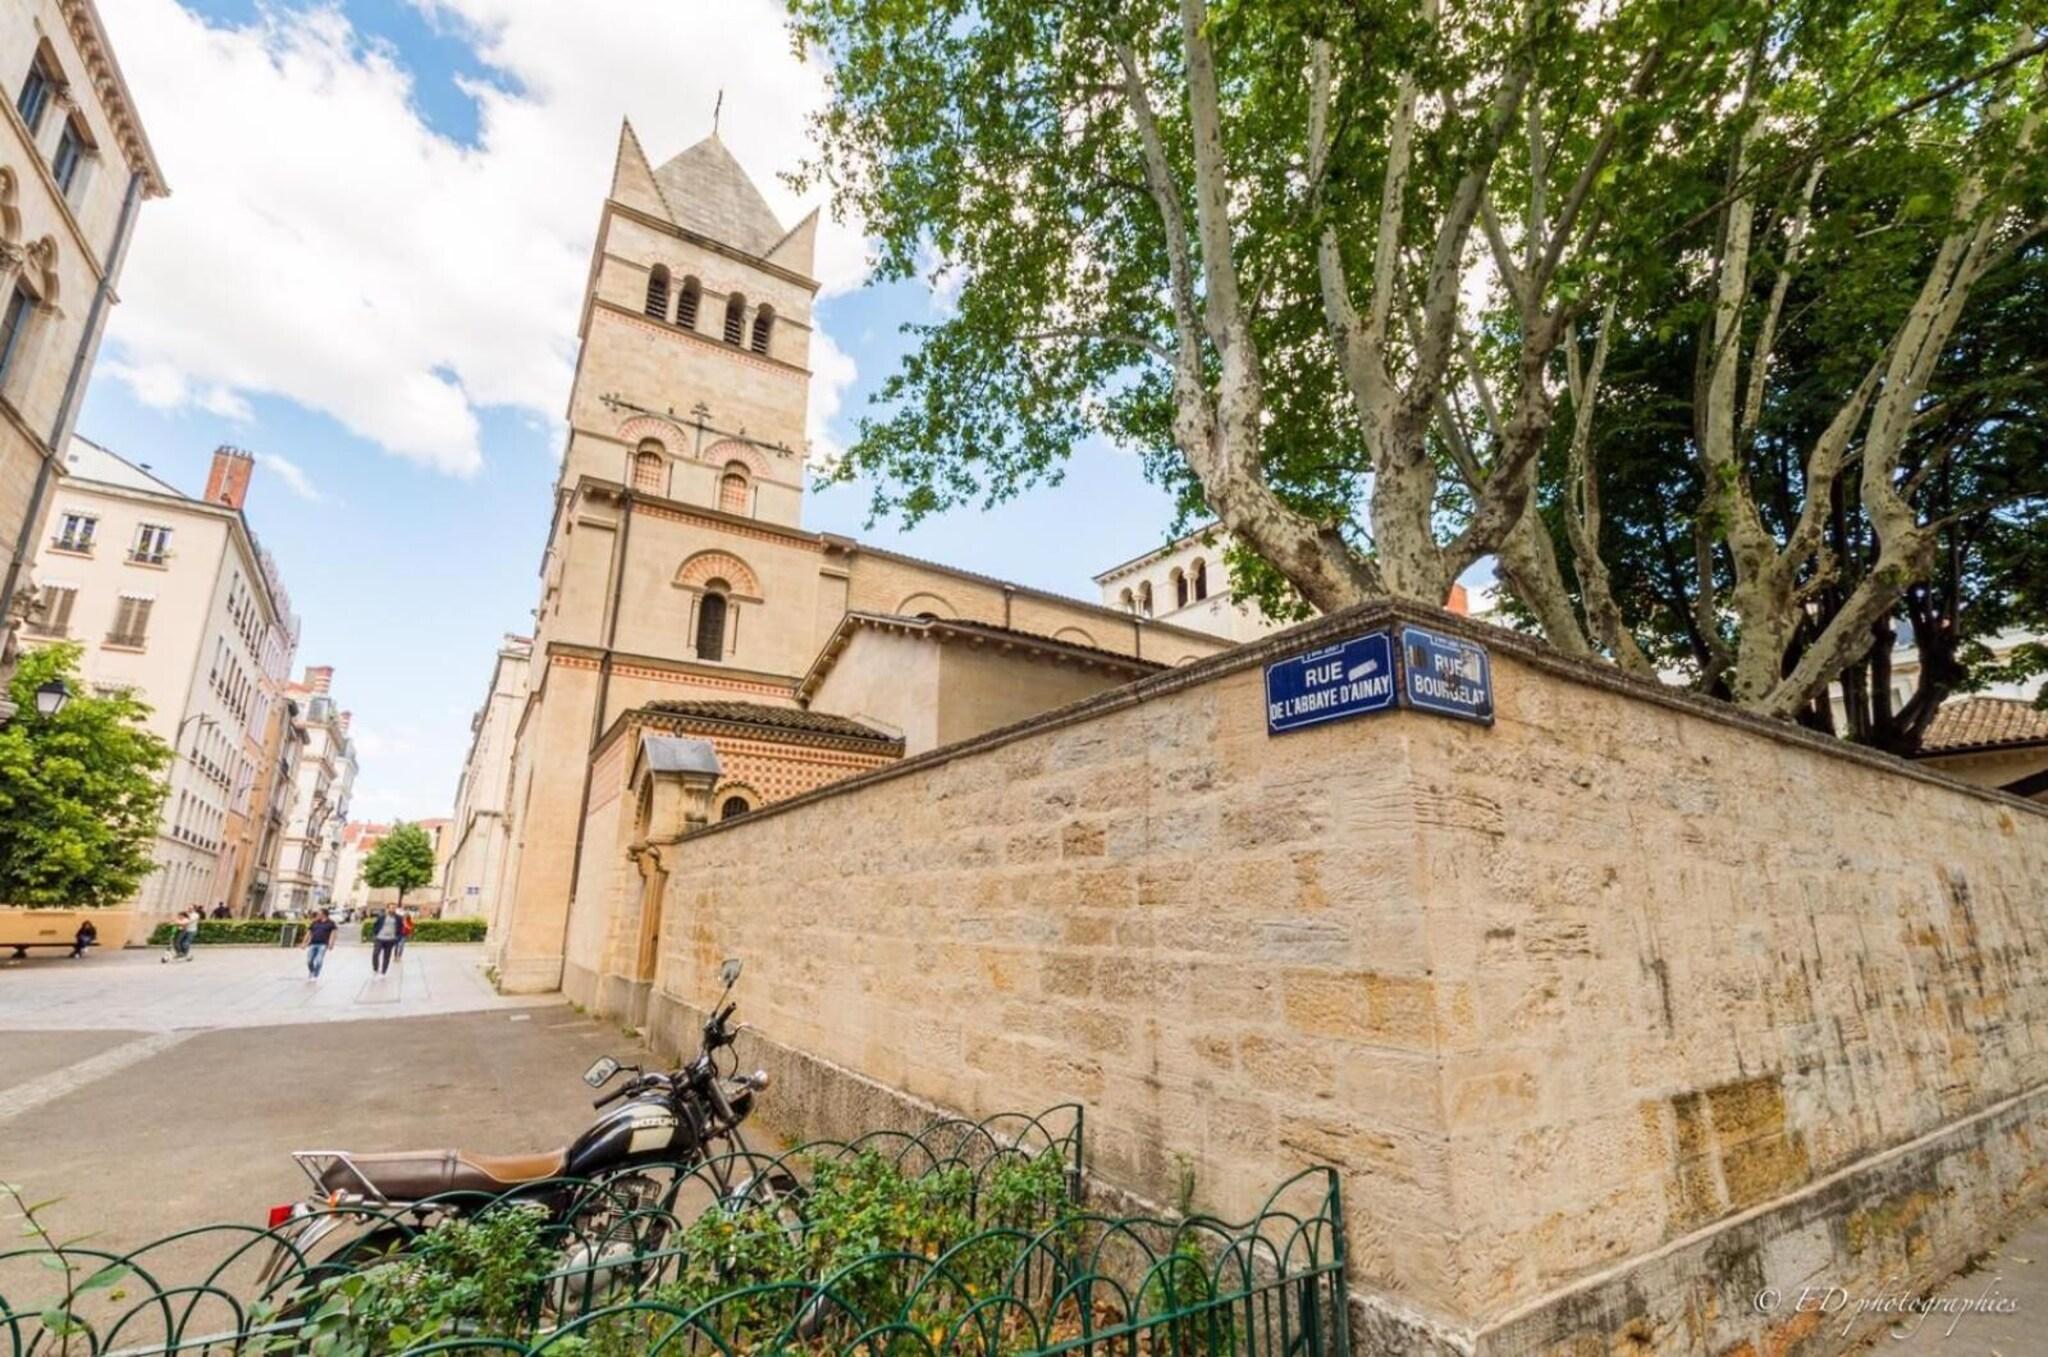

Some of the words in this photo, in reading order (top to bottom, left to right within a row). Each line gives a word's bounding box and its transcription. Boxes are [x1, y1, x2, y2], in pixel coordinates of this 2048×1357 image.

[1305, 661, 1343, 687] RUE
[1434, 653, 1463, 677] RUE
[1271, 702, 1285, 720] DE
[1285, 688, 1338, 717] L'ABBAYE
[1340, 675, 1389, 704] D'AINAY
